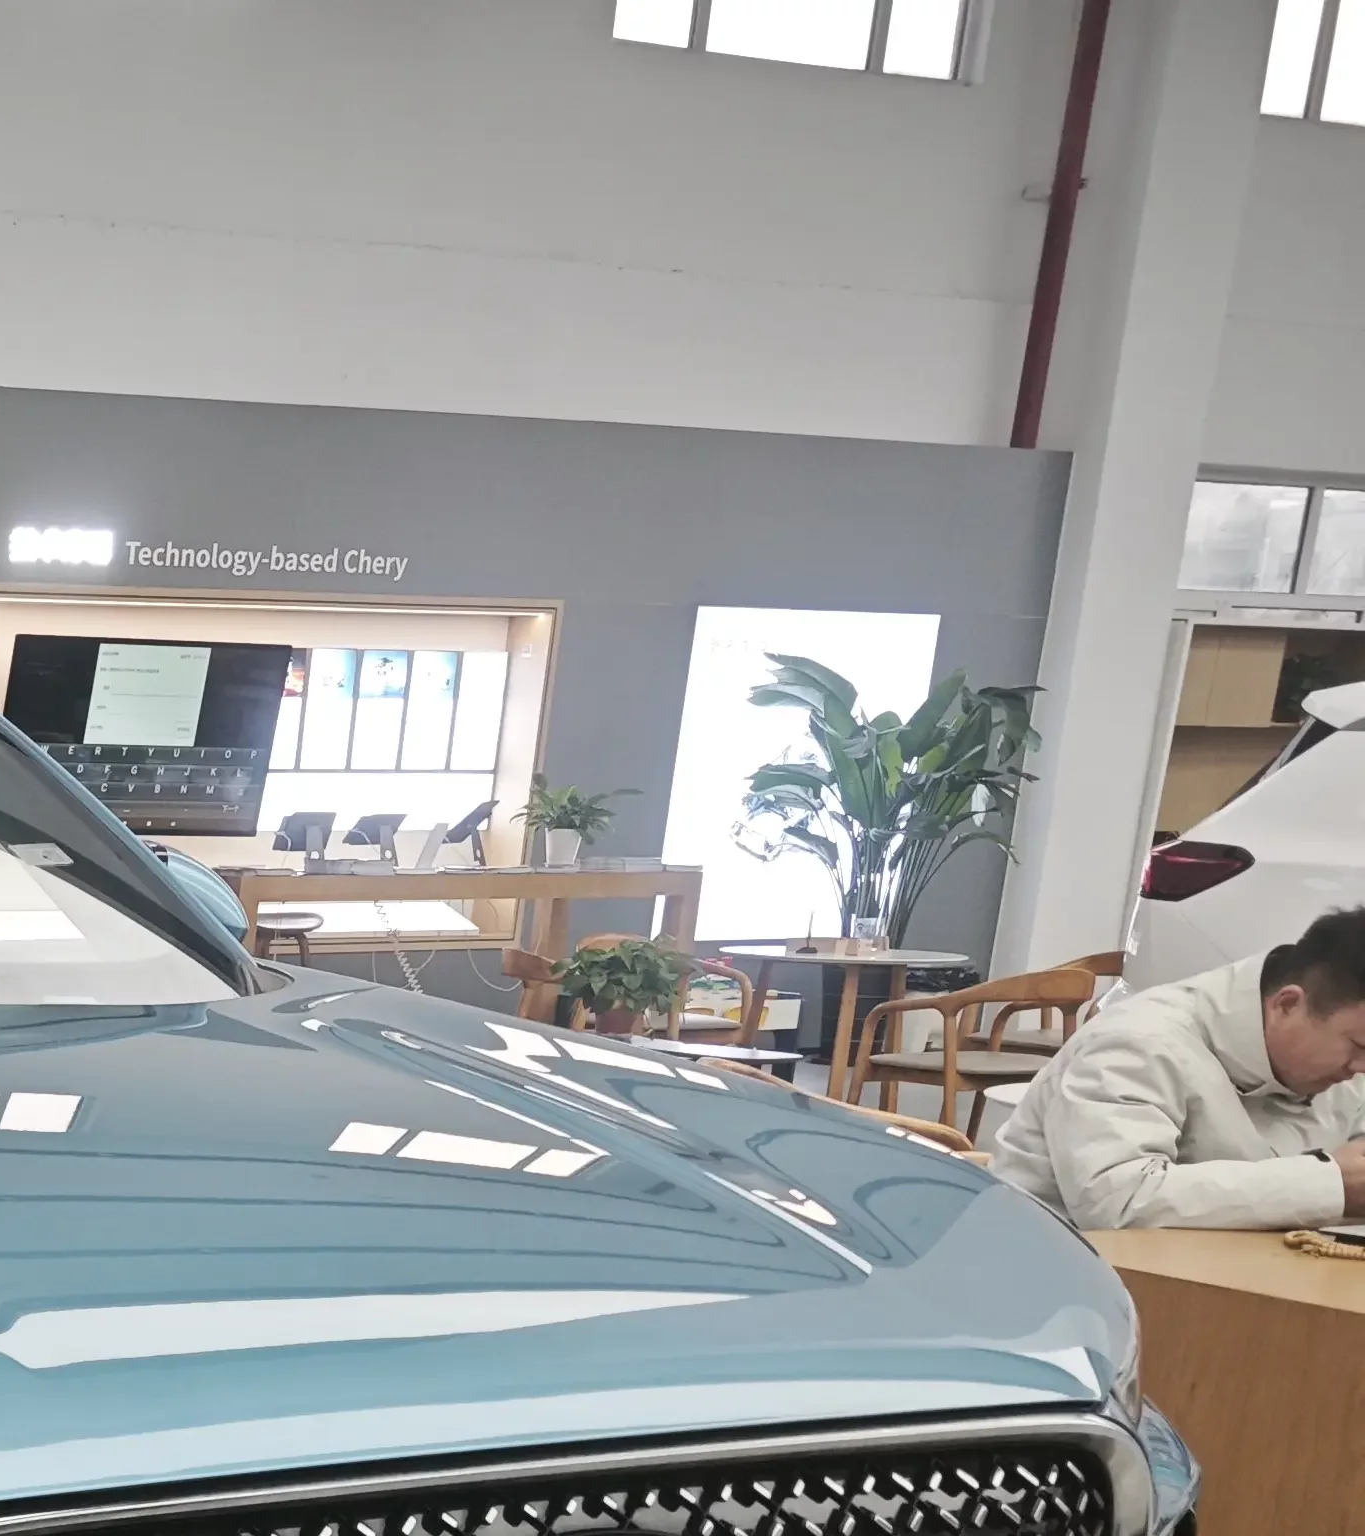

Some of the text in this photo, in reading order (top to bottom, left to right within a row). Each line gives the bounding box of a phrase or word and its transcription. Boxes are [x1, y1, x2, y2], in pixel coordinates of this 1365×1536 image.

[125, 541, 339, 576] Technology-based
[344, 549, 408, 582] Chery
[68, 745, 75, 755] E
[94, 746, 102, 755] R
[122, 746, 128, 756] T
[148, 747, 155, 756] Y
[173, 748, 181, 757] U
[250, 750, 257, 759] P
[76, 764, 84, 773] D
[130, 765, 138, 774] G
[157, 766, 165, 775] H
[210, 767, 218, 776] K
[100, 783, 215, 794] C V B N M
